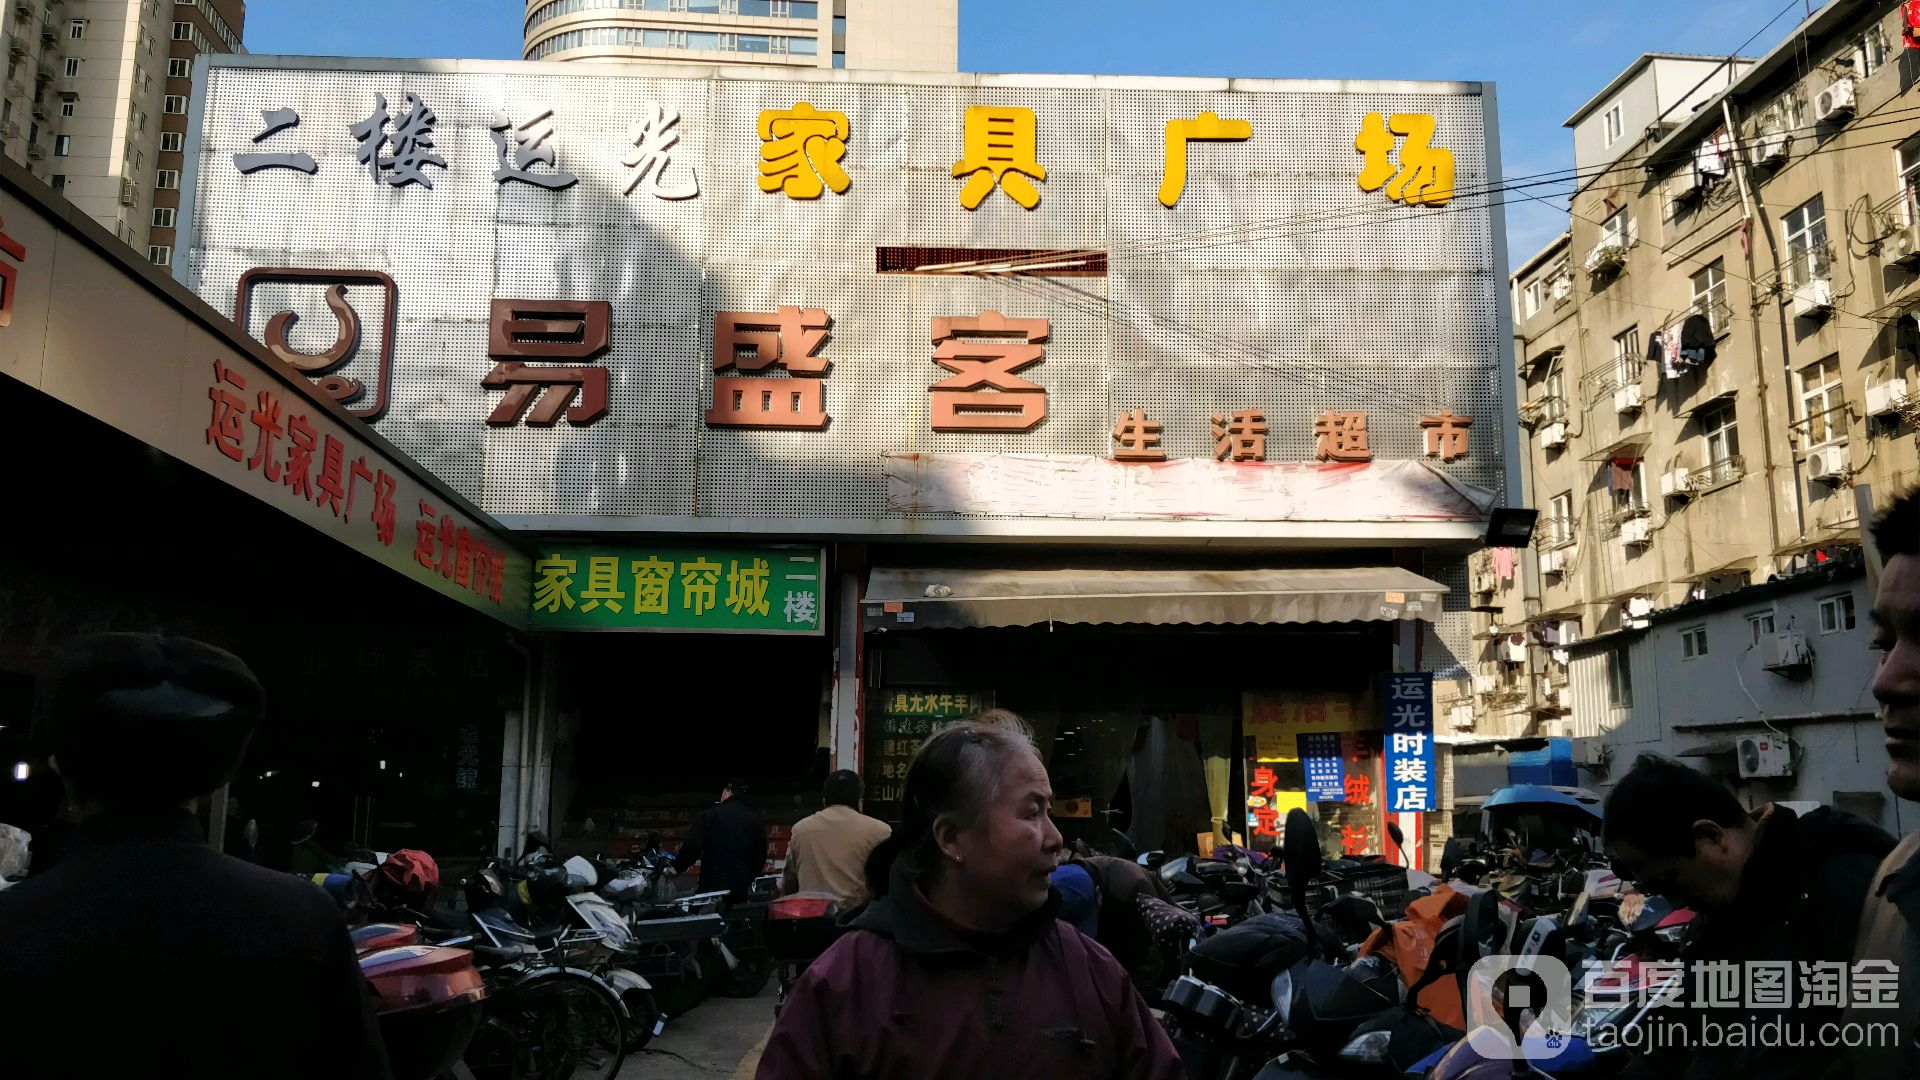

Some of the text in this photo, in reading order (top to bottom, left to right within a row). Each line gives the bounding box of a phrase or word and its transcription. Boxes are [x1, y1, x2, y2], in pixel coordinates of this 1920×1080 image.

[233, 91, 1455, 210] 二楼运光 家具广场
[481, 299, 1050, 433] 易盛客
[206, 359, 397, 545] 运光家具广场
[1111, 408, 1472, 462] 生活超市
[532, 554, 771, 616] 家具窗帘城
[784, 556, 817, 623] 二楼
[1391, 677, 1428, 811] 运光时装店
